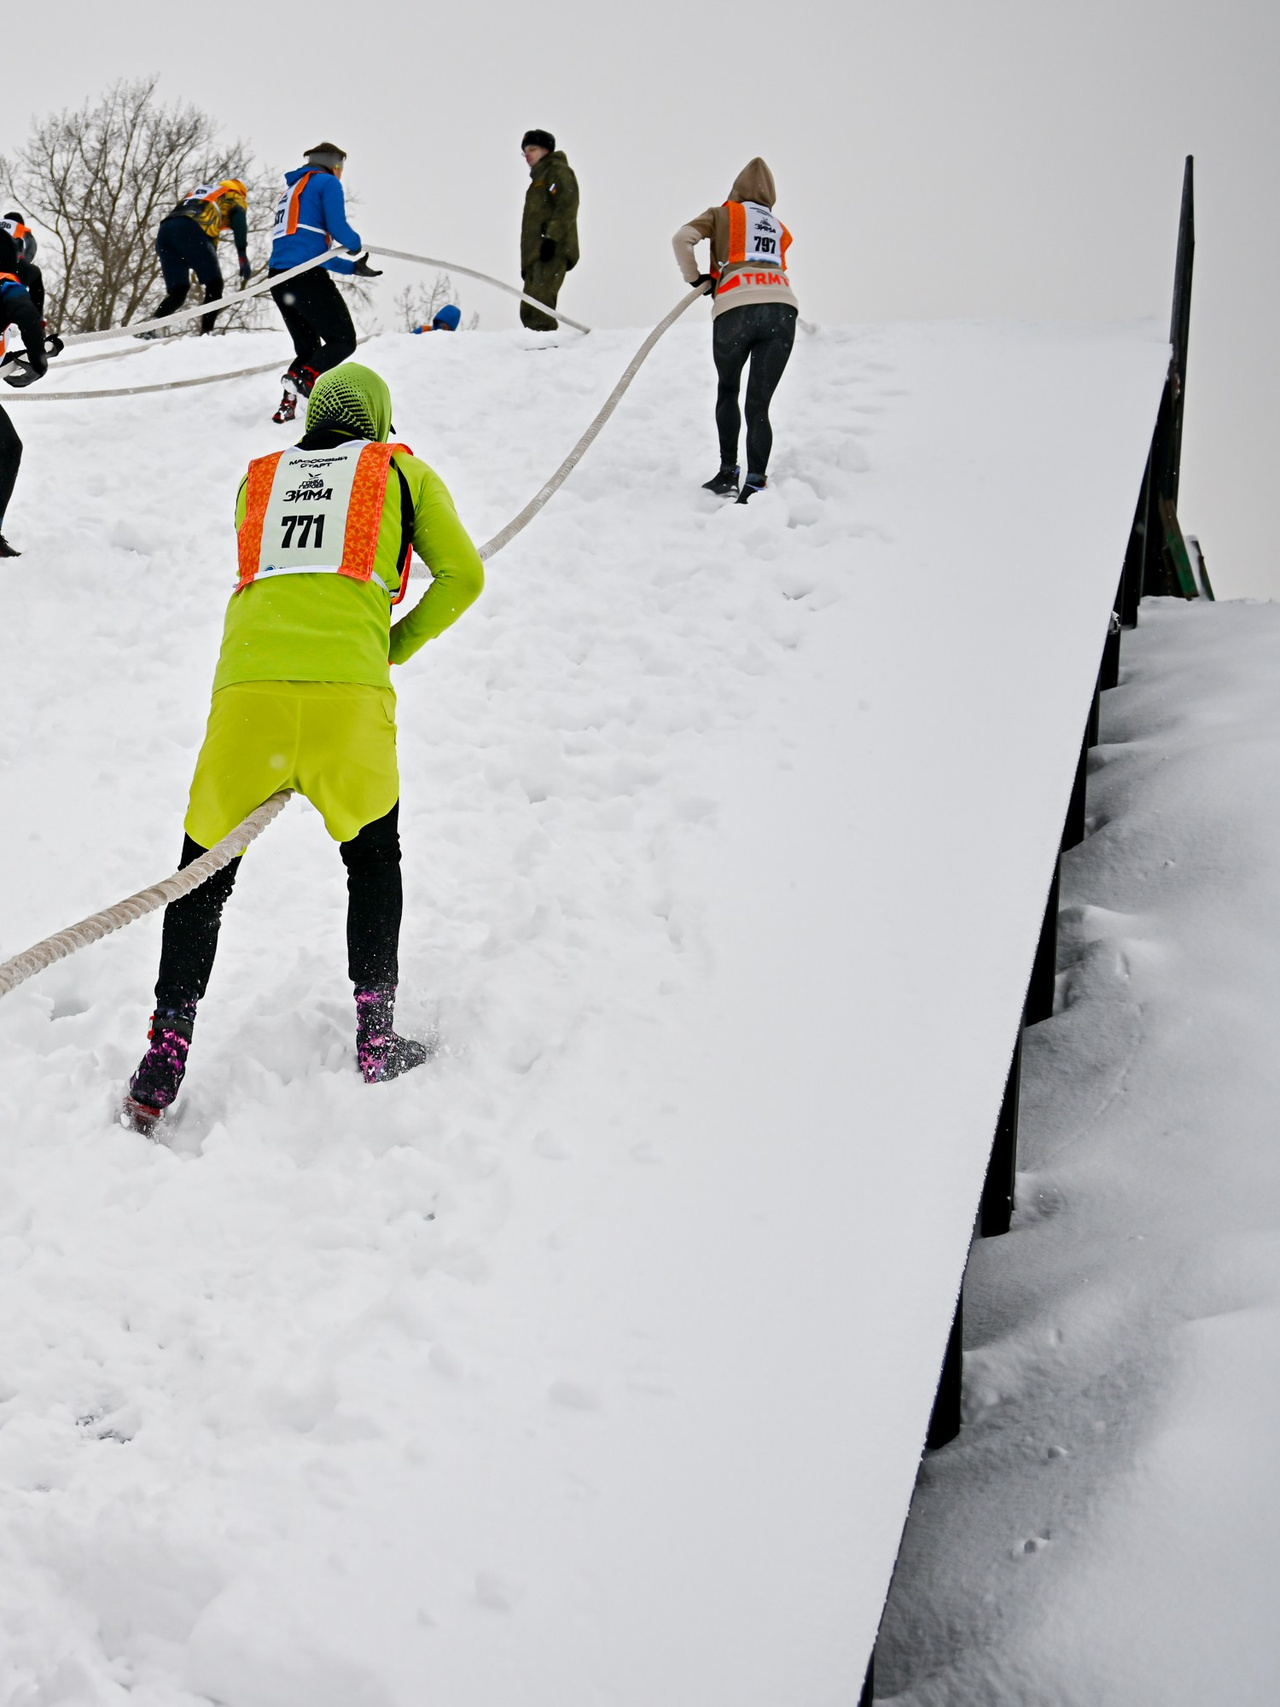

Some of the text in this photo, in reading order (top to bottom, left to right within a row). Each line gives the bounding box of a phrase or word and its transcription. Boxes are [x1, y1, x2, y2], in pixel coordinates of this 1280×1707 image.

[754, 236, 776, 254] 797
[283, 488, 333, 503] ЗИМА
[281, 514, 325, 548] 771
